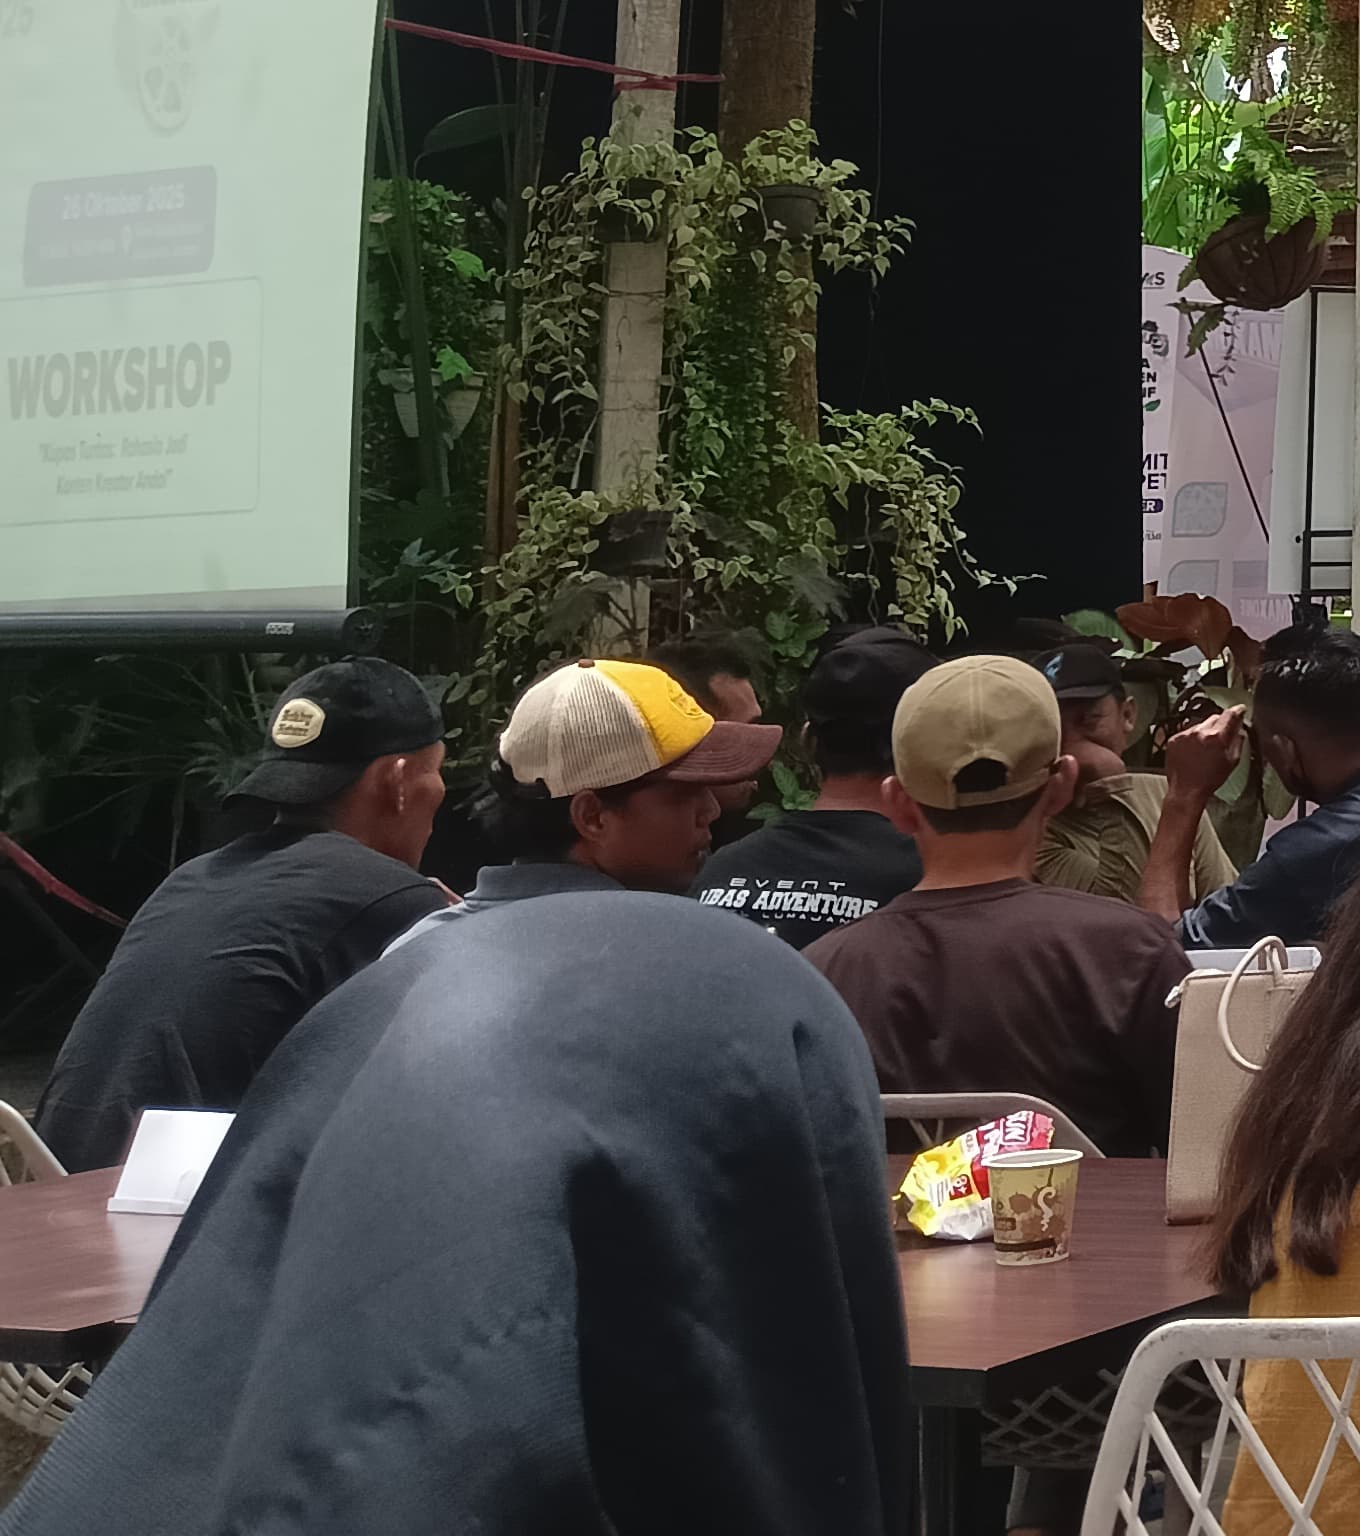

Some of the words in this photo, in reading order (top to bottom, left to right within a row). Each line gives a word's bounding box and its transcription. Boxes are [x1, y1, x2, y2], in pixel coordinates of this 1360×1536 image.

[7, 340, 232, 420] WORKSHOP
[730, 877, 845, 891] EVENT
[752, 890, 879, 919] ADVENTURE
[762, 913, 850, 925] LUMAJAN
